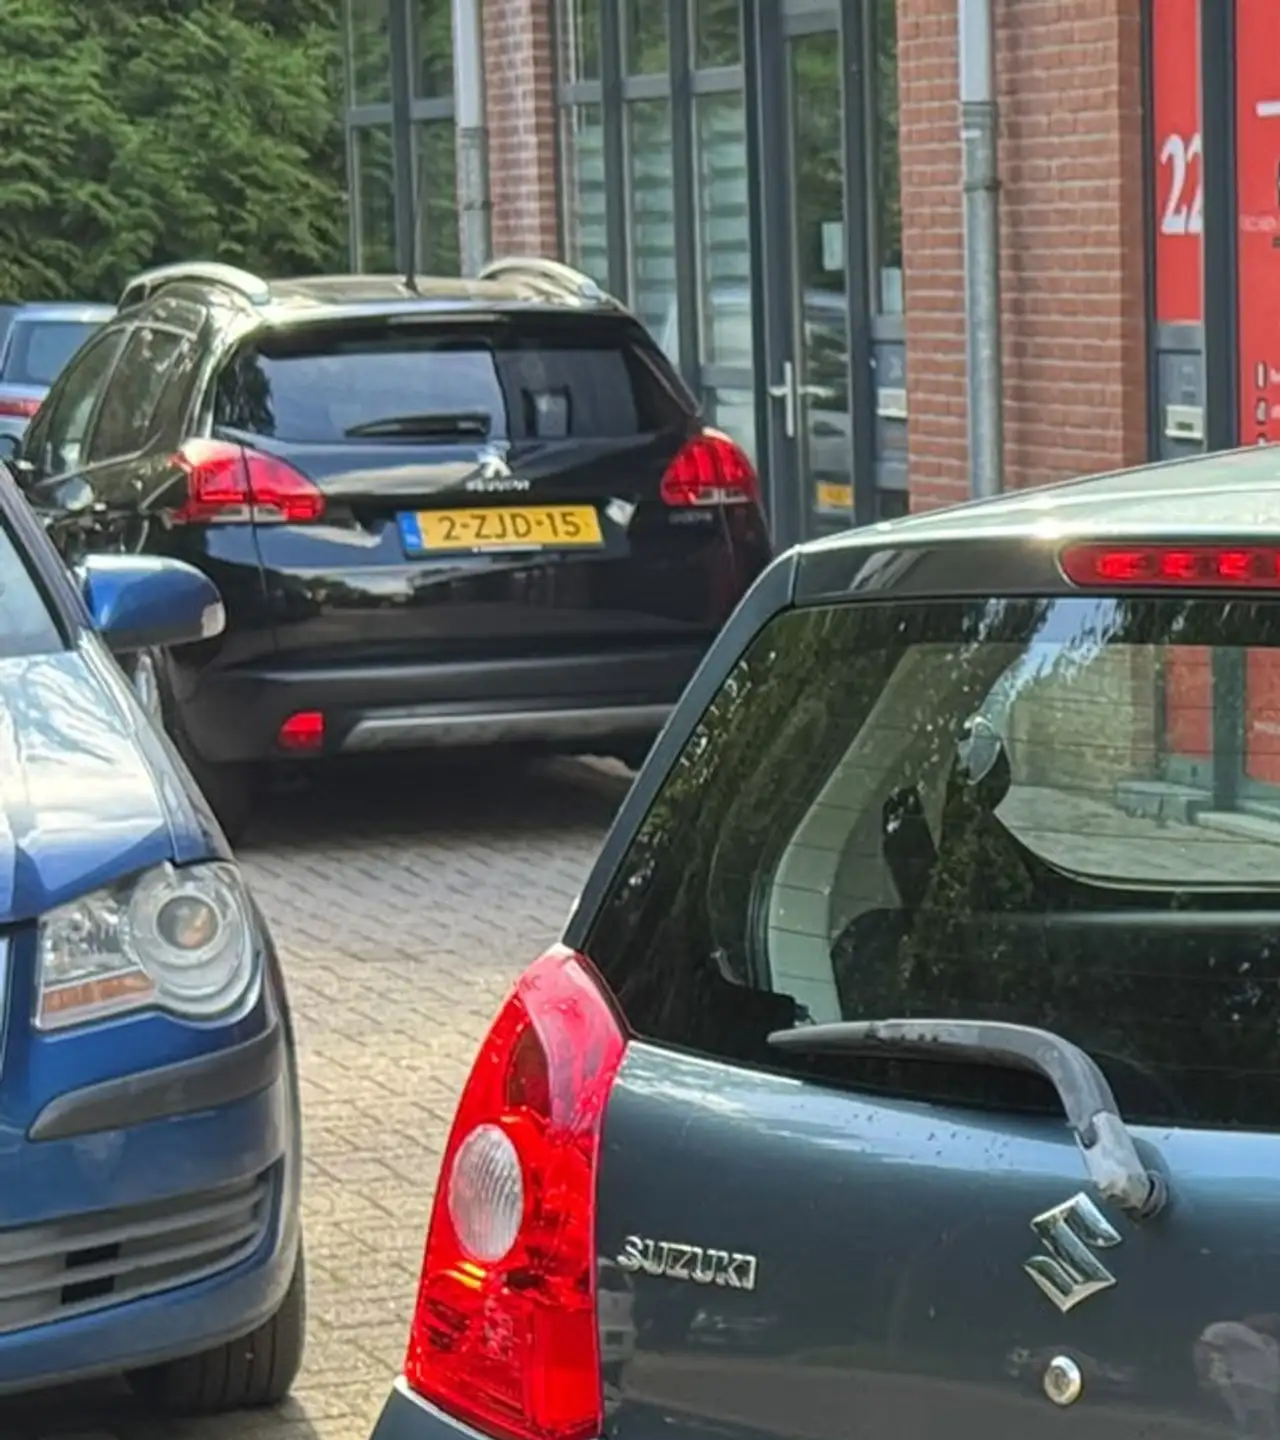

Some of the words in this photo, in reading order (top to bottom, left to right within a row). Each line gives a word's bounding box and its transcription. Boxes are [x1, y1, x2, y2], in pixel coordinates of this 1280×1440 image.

[1160, 132, 1203, 235] 22
[437, 510, 582, 541] 2-ZJD-15
[616, 1234, 757, 1291] SUZUKI
